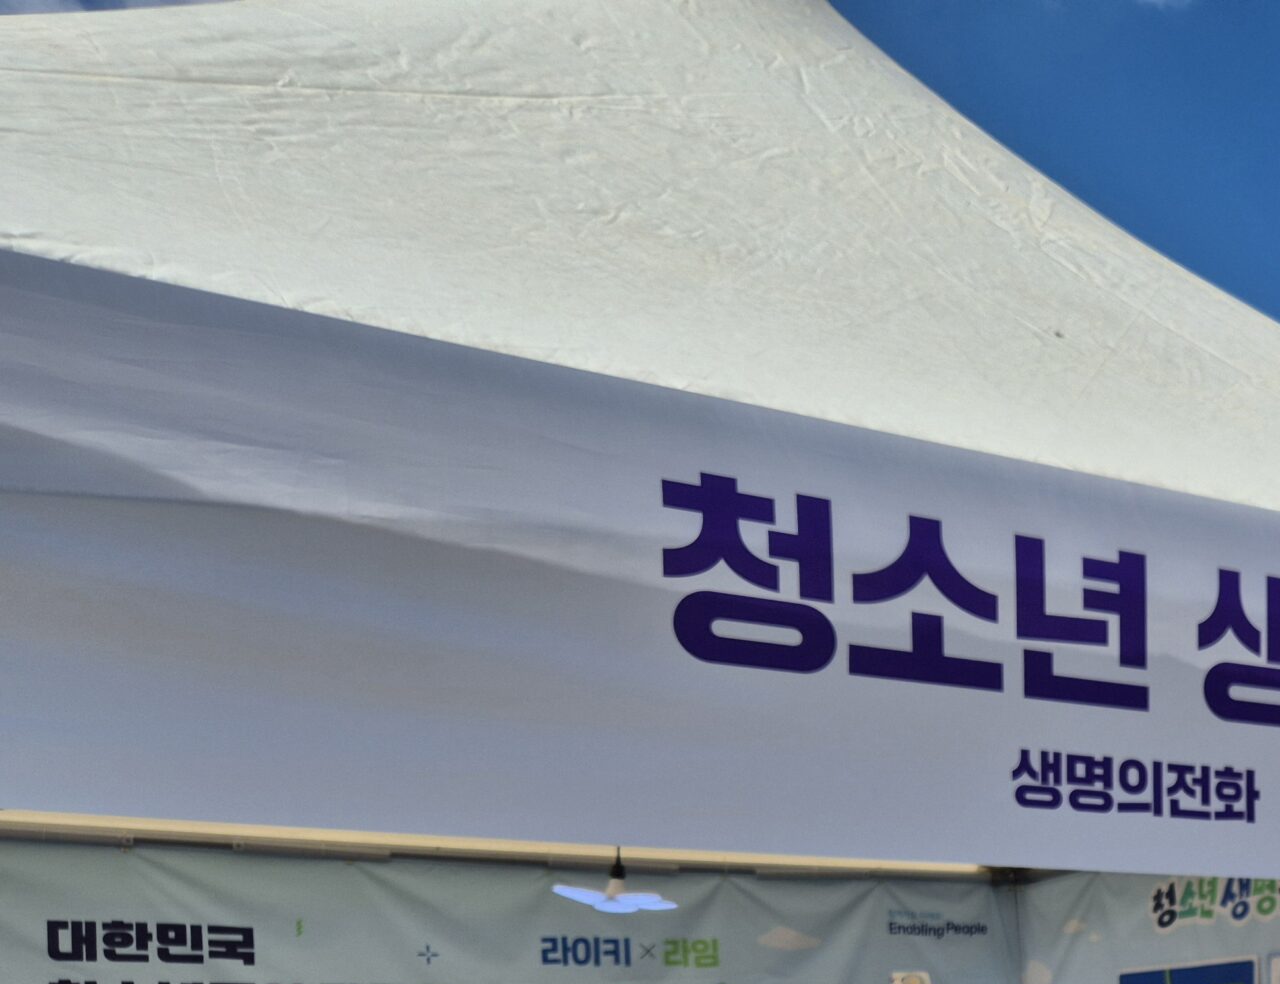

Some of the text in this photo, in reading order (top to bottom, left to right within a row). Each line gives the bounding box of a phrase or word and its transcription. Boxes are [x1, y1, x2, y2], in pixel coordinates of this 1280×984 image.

[661, 471, 1150, 713] 청소년
[1012, 748, 1261, 824] 생명의전화
[46, 919, 256, 966] 대한민국
[541, 935, 632, 968] 라이키
[662, 936, 721, 969] 라임
[889, 921, 988, 940] Enabling People
